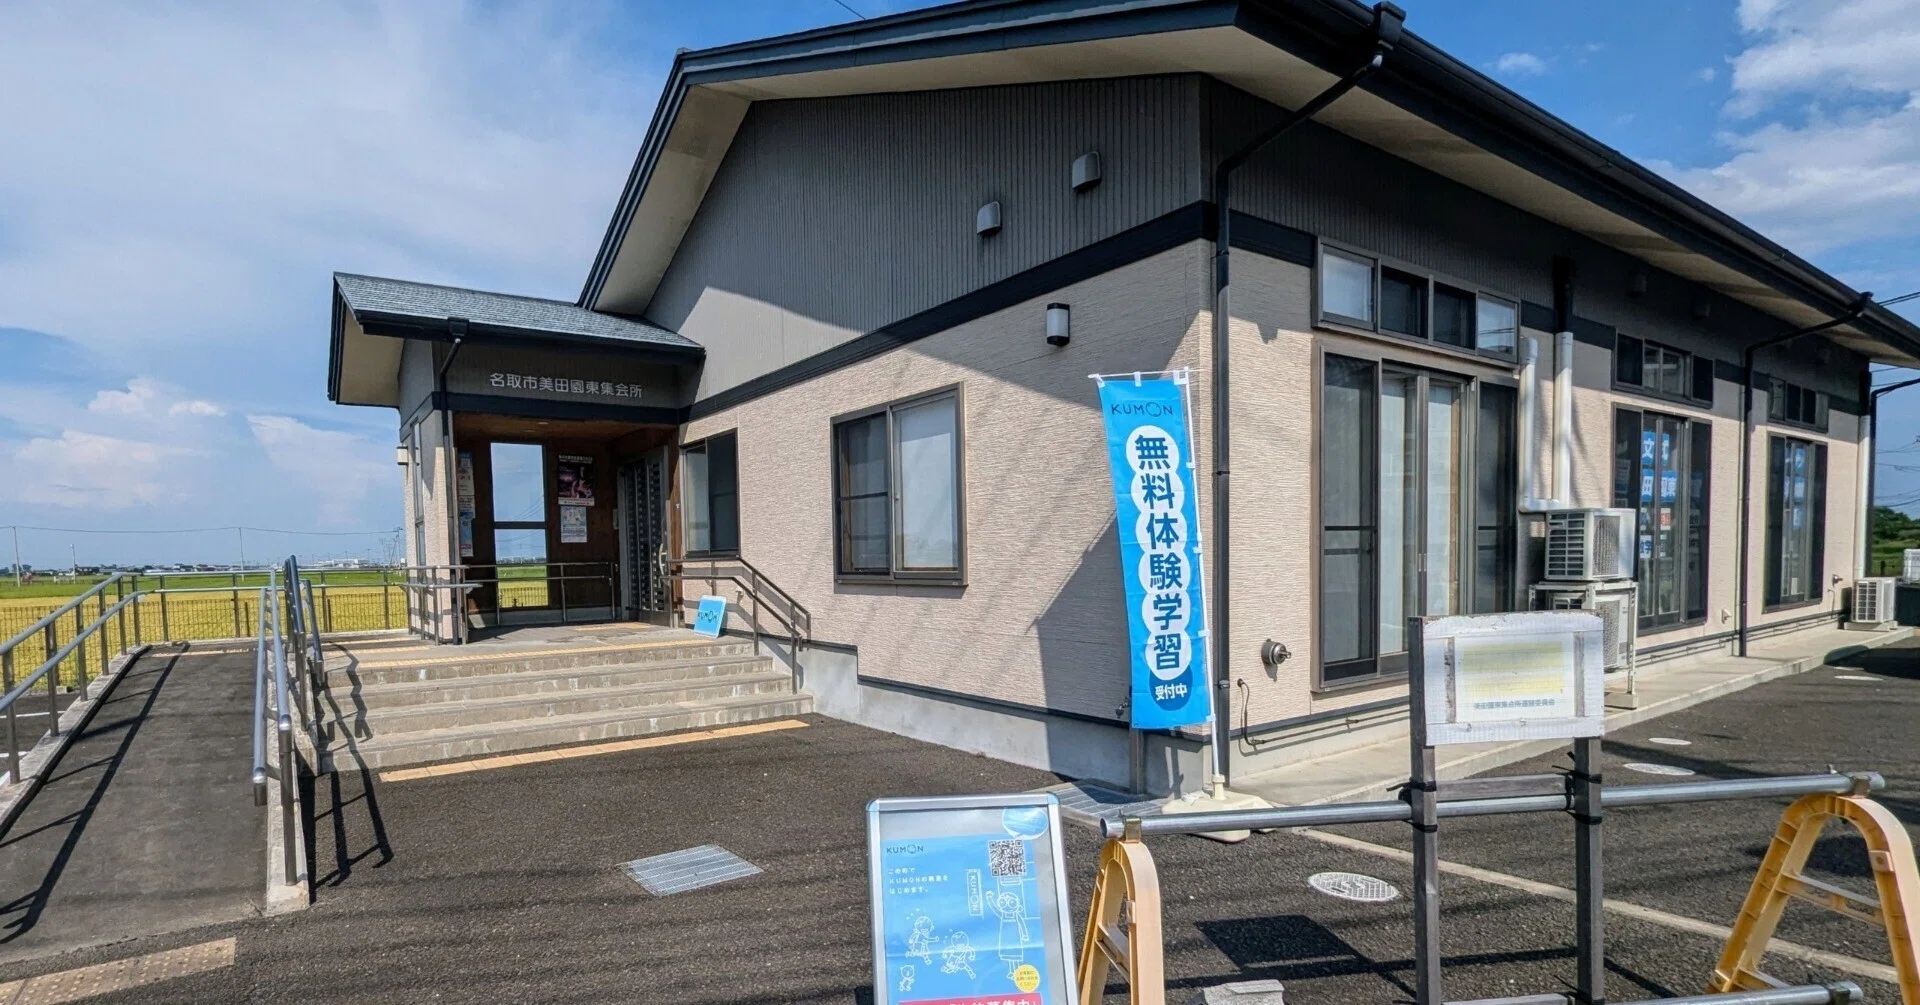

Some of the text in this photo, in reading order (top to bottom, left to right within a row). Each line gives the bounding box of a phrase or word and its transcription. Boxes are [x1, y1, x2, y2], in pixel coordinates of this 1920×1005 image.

[490, 372, 643, 398] 名取市美田園東集会所
[1111, 402, 1173, 417] KUMON
[1134, 434, 1183, 671] 無料体験学習
[1154, 683, 1188, 701] 受付中
[886, 844, 924, 854] KUMON
